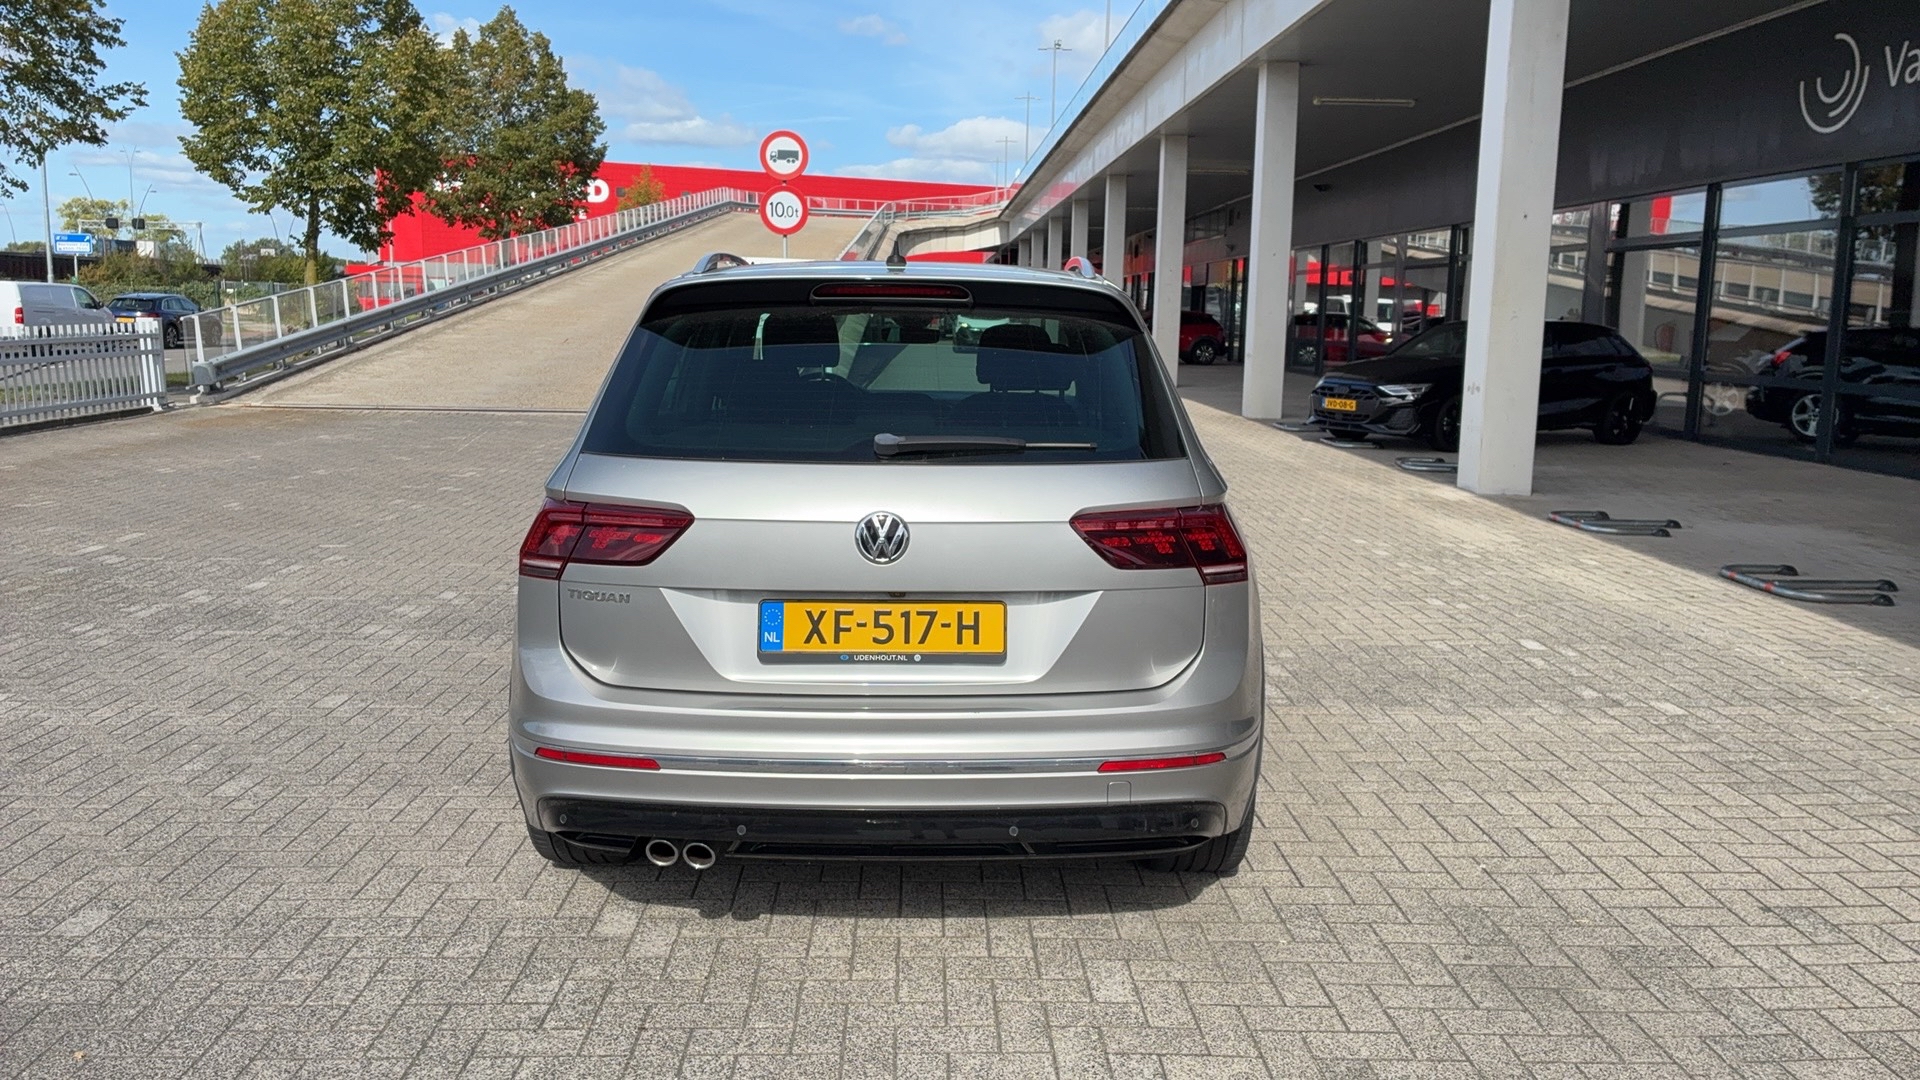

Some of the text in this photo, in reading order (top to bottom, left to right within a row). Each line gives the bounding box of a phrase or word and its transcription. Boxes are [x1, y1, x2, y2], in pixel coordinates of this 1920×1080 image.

[567, 588, 631, 604] TIGUAN
[803, 609, 980, 645] XF-517-H
[764, 631, 781, 643] NL
